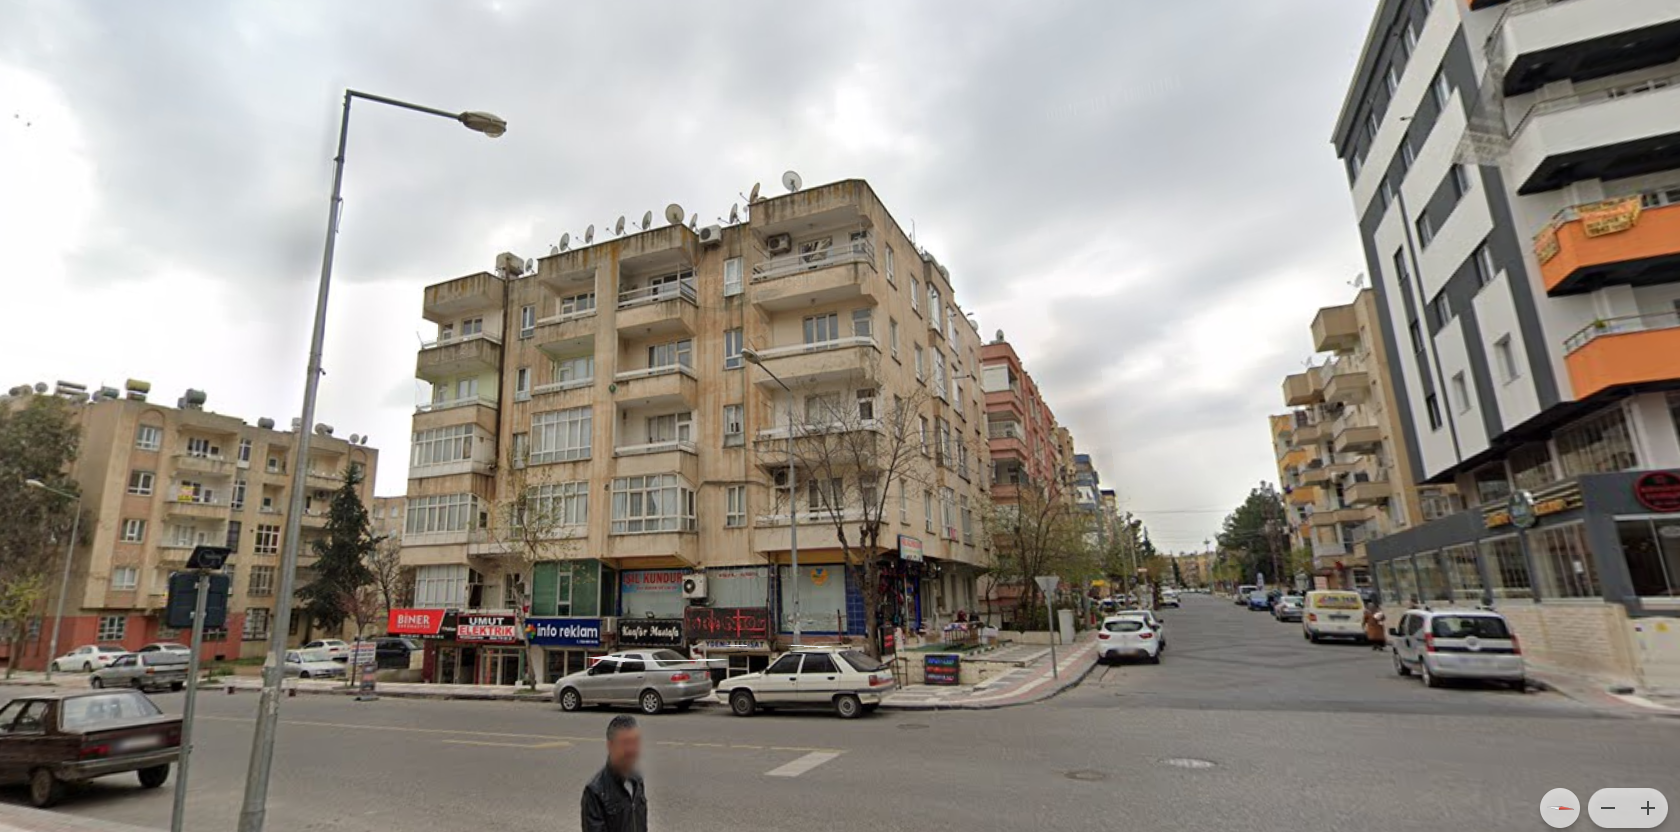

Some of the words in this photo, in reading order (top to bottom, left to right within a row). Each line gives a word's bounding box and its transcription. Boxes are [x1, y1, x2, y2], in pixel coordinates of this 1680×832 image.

[643, 572, 683, 584] KUNDUR
[397, 613, 430, 625] BİNER
[469, 617, 504, 626] UMUT
[537, 623, 557, 637] info
[559, 624, 598, 638] reklam
